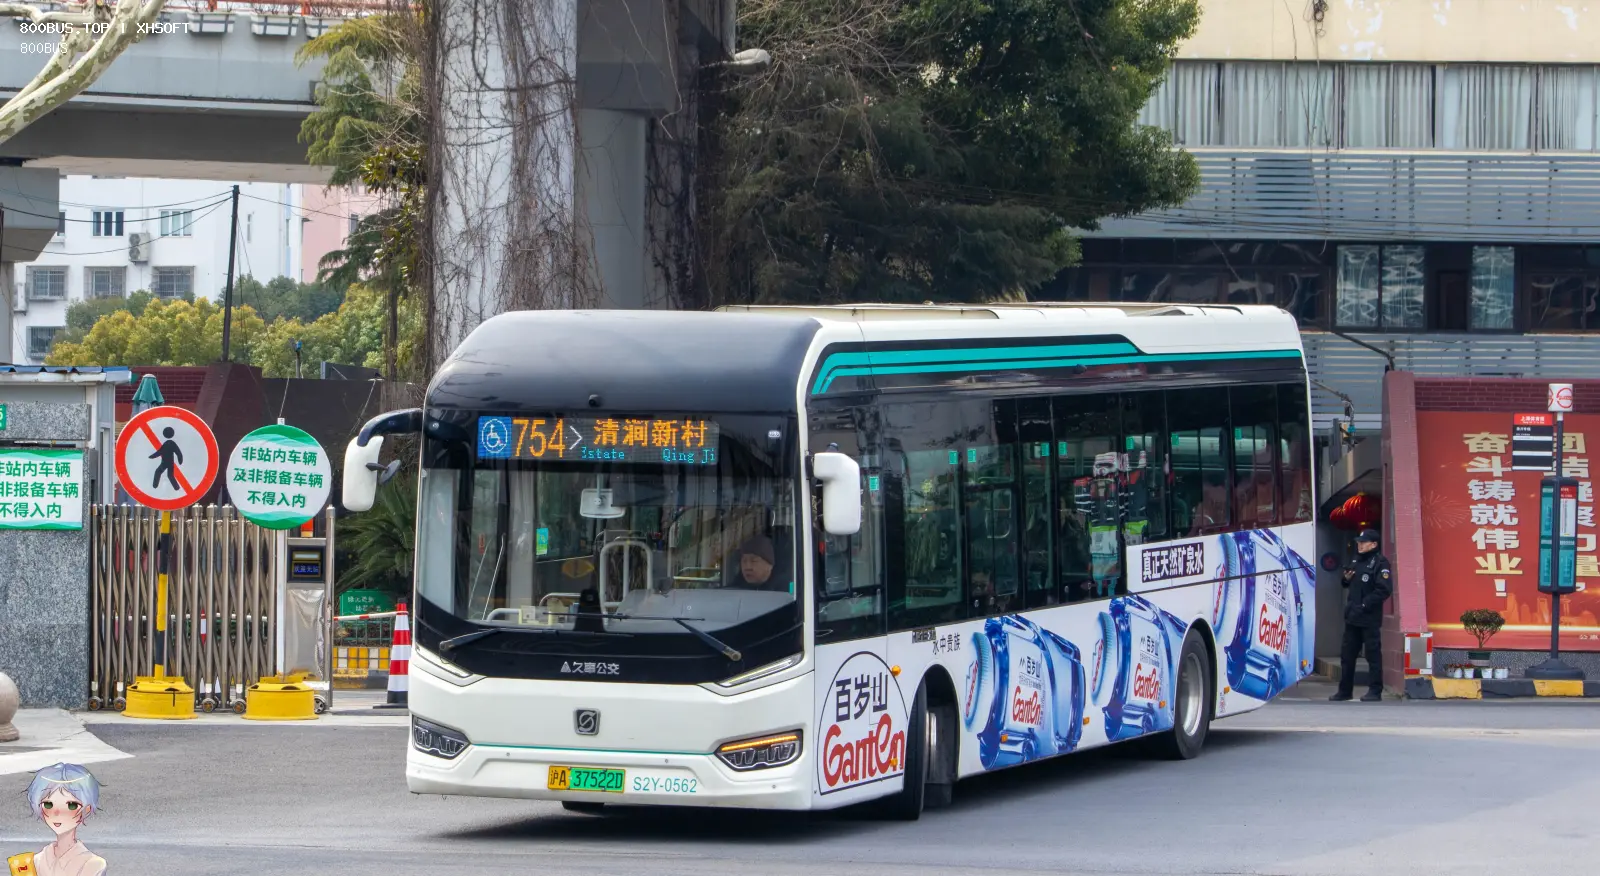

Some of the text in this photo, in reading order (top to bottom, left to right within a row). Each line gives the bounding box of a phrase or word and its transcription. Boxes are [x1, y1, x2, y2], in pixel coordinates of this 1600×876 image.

[512, 418, 567, 458] 754
[593, 418, 709, 448] 清涧新村
[241, 446, 318, 467] 非站内车辆
[661, 448, 695, 463] Qing
[701, 448, 716, 464] Ji
[233, 467, 324, 489] 及非报备车辆
[0, 502, 62, 518] 不得入内
[247, 490, 306, 509] 不得入内
[1462, 431, 1524, 597] 奋斗铸就伟业！
[1143, 544, 1204, 581] 真正天然矿泉水
[932, 632, 961, 655] 水中贵族
[835, 672, 888, 722] 百岁山
[573, 770, 624, 789] 37522D
[633, 776, 698, 793] S2Y-0562
